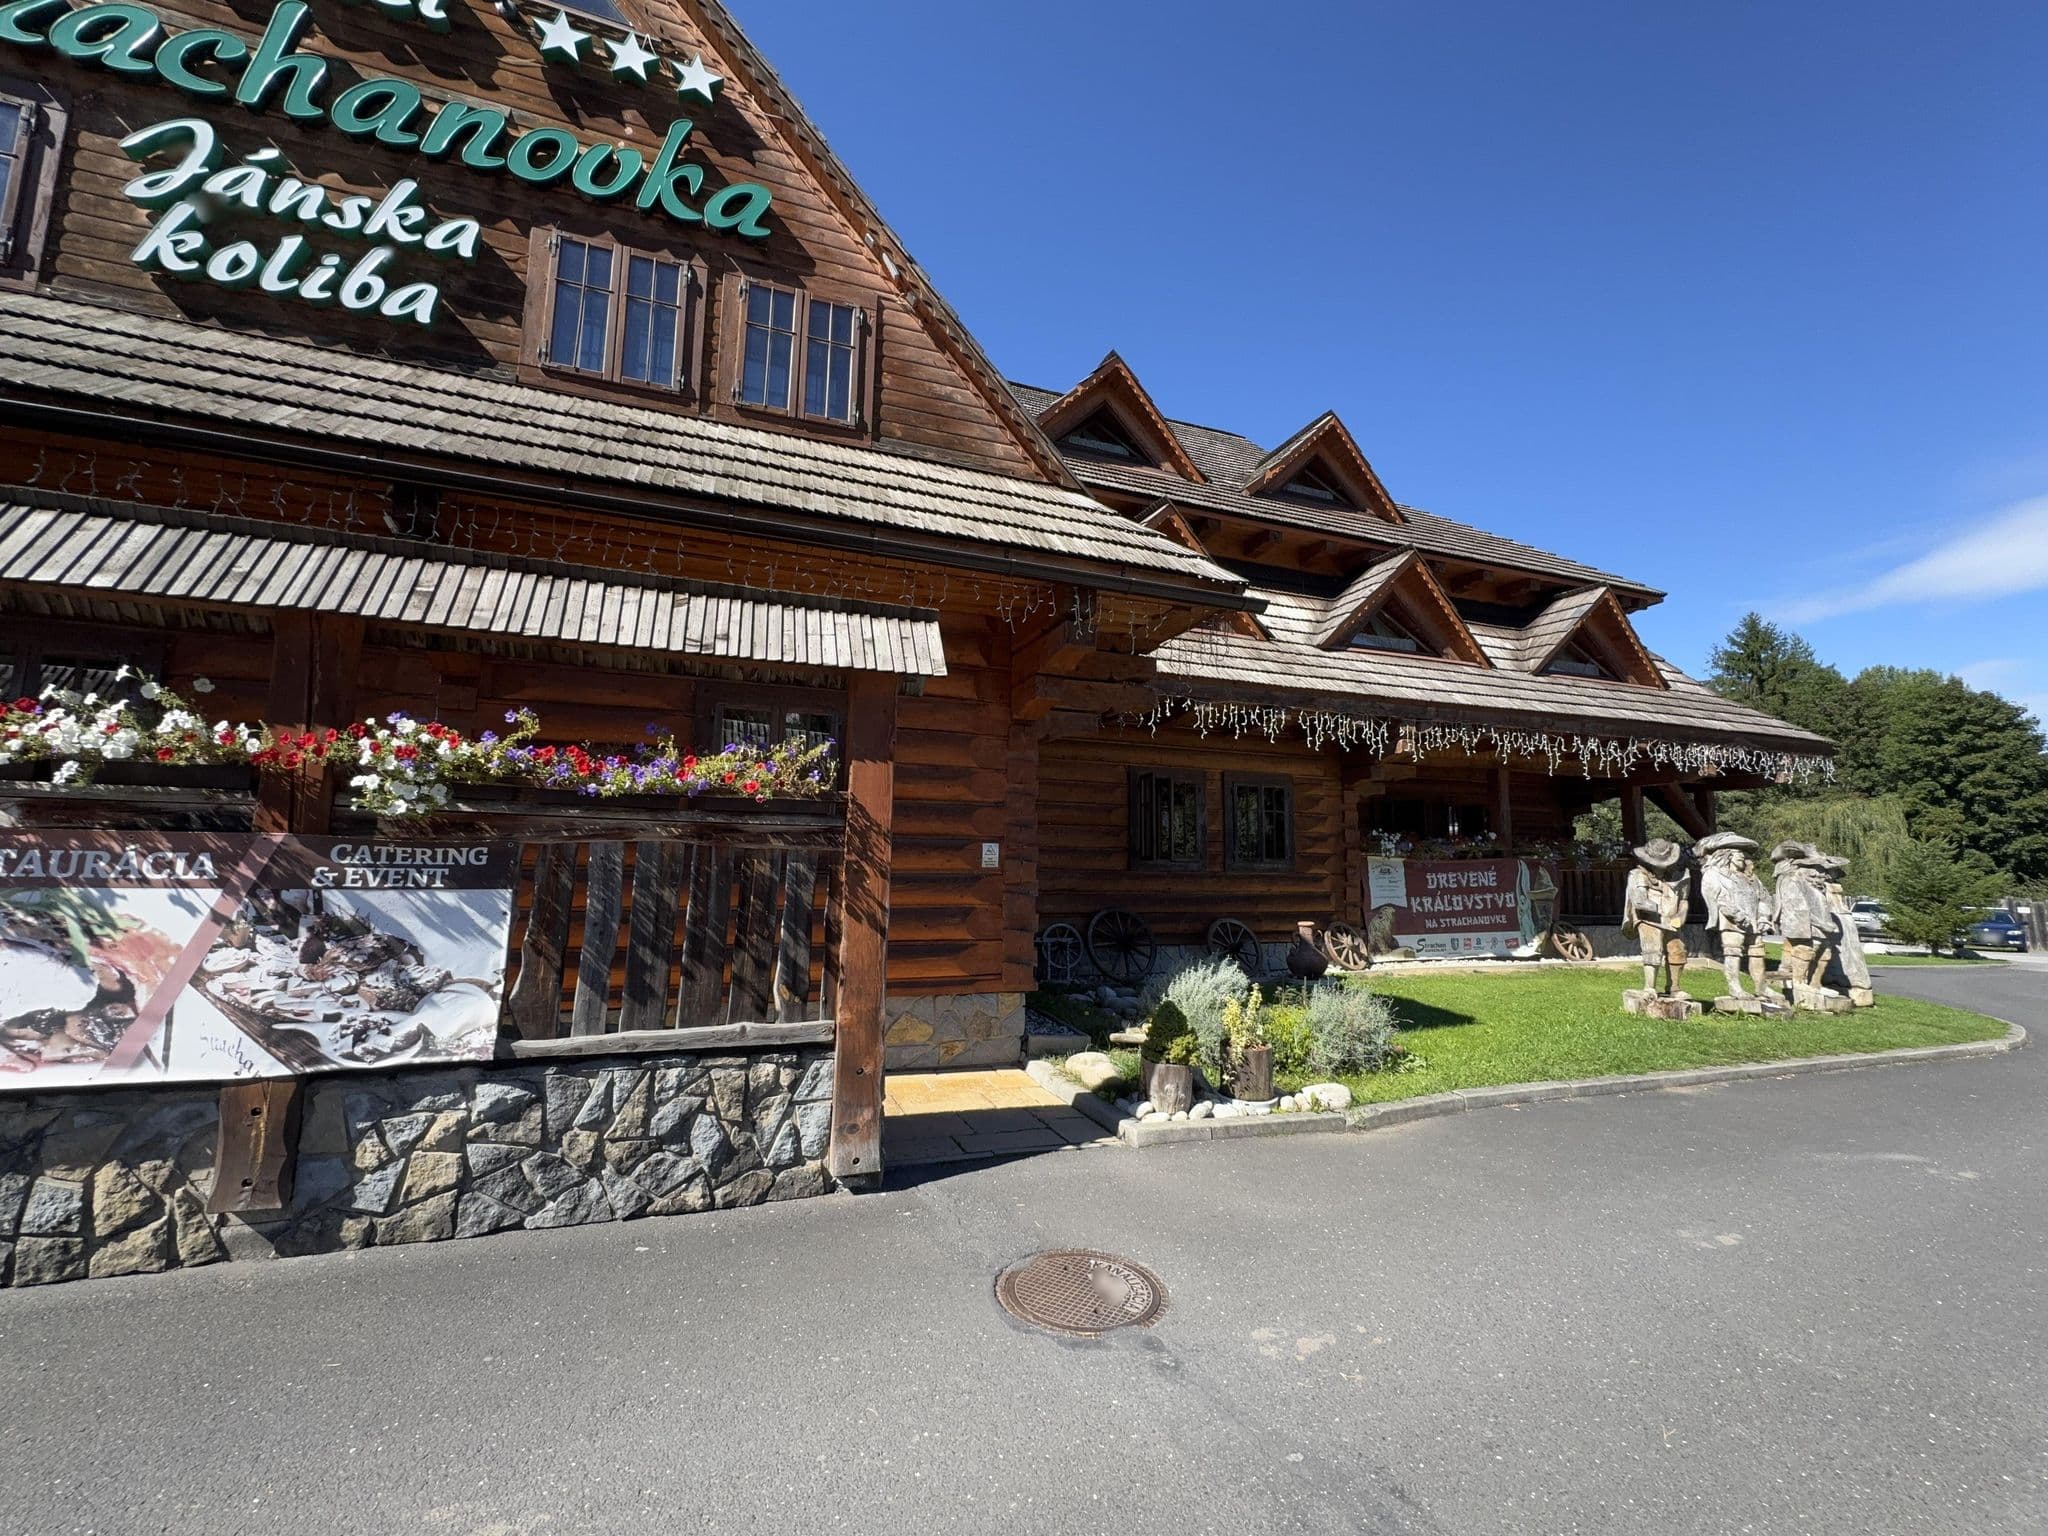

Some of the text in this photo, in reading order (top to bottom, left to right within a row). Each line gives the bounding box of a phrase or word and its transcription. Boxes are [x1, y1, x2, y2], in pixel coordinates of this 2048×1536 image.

[118, 118, 481, 258] Jánska
[132, 200, 439, 324] koliba
[330, 843, 488, 866] CATERING
[311, 866, 449, 888] & EVENT
[1426, 865, 1498, 889] DREVENÉ
[1425, 918, 1438, 929] NA
